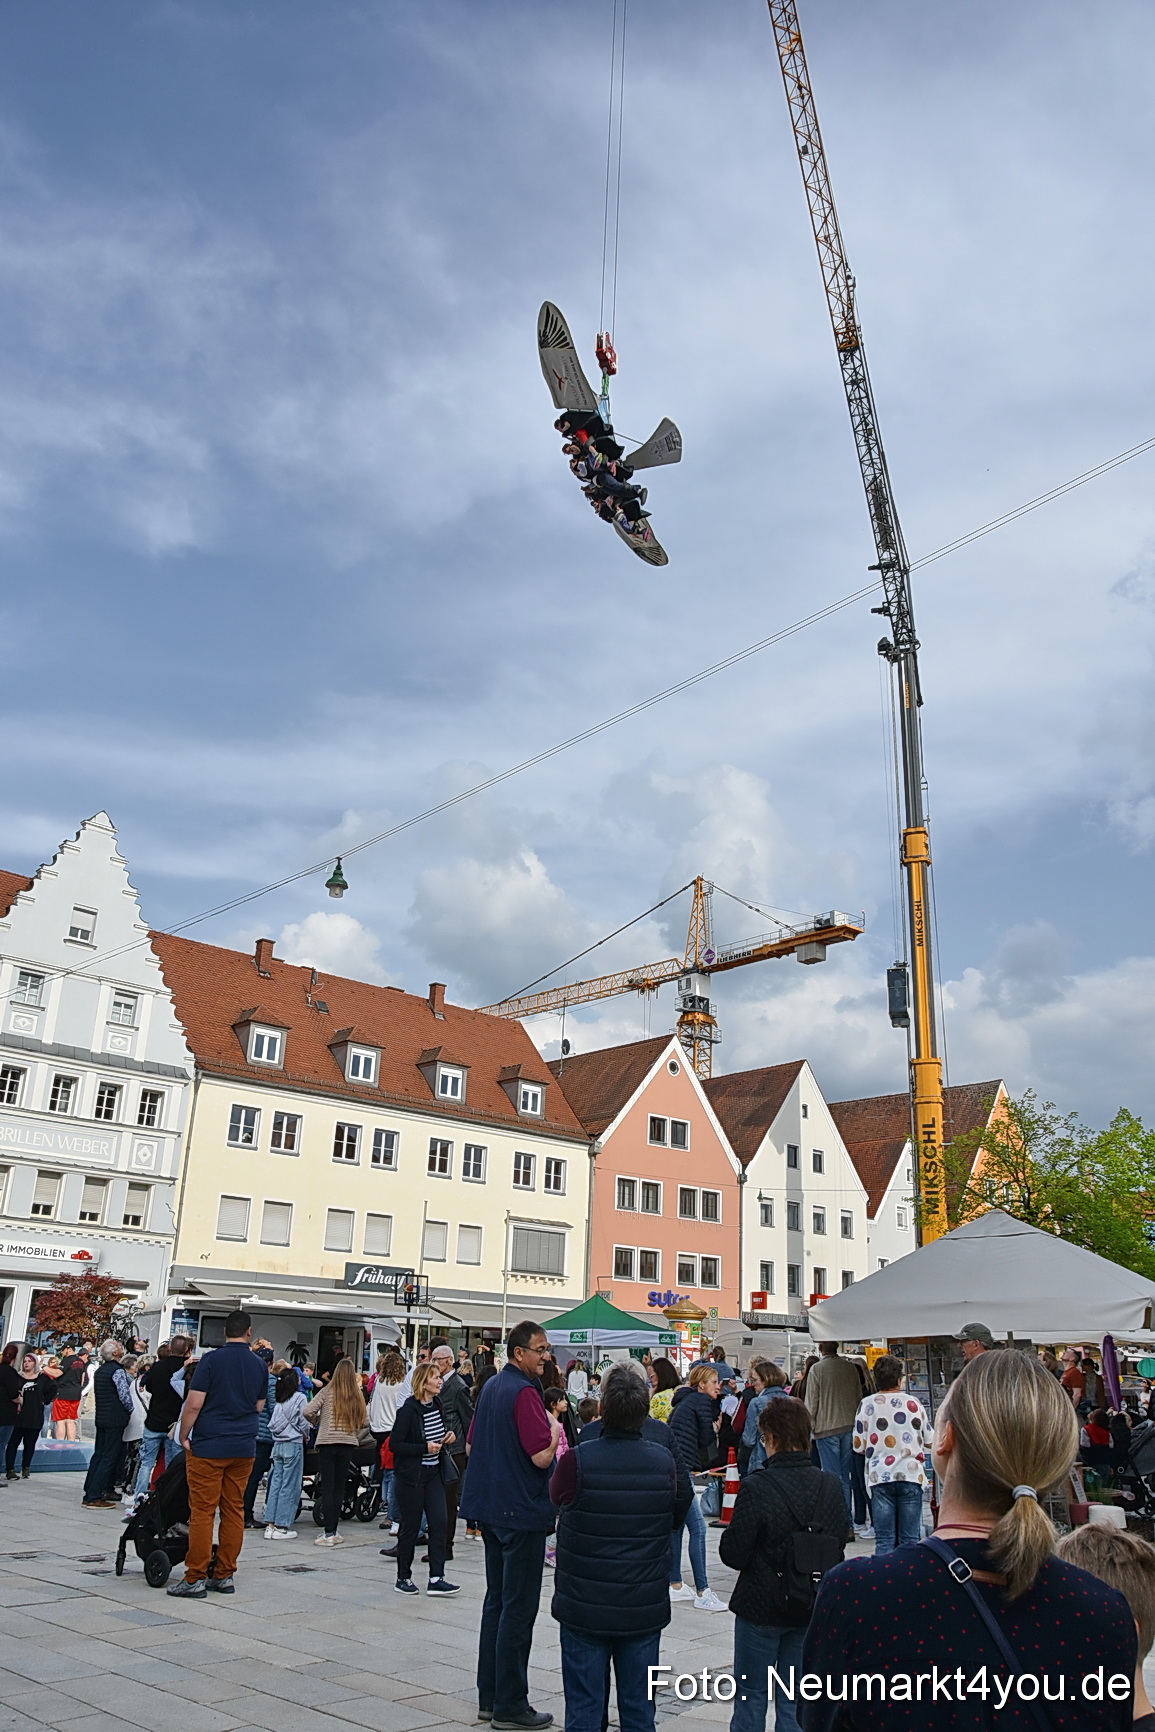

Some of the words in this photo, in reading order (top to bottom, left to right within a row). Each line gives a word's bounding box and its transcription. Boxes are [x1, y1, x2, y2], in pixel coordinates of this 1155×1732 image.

[914, 896, 924, 947] MIKSCHL
[719, 950, 752, 963] LIEBHERR
[0, 1126, 55, 1148] BRILLEN
[57, 1134, 109, 1156] WEBER
[922, 1116, 940, 1215] MIKSCHL
[6, 1245, 66, 1258] IMMOBILIEN
[576, 1350, 588, 1358] AOK
